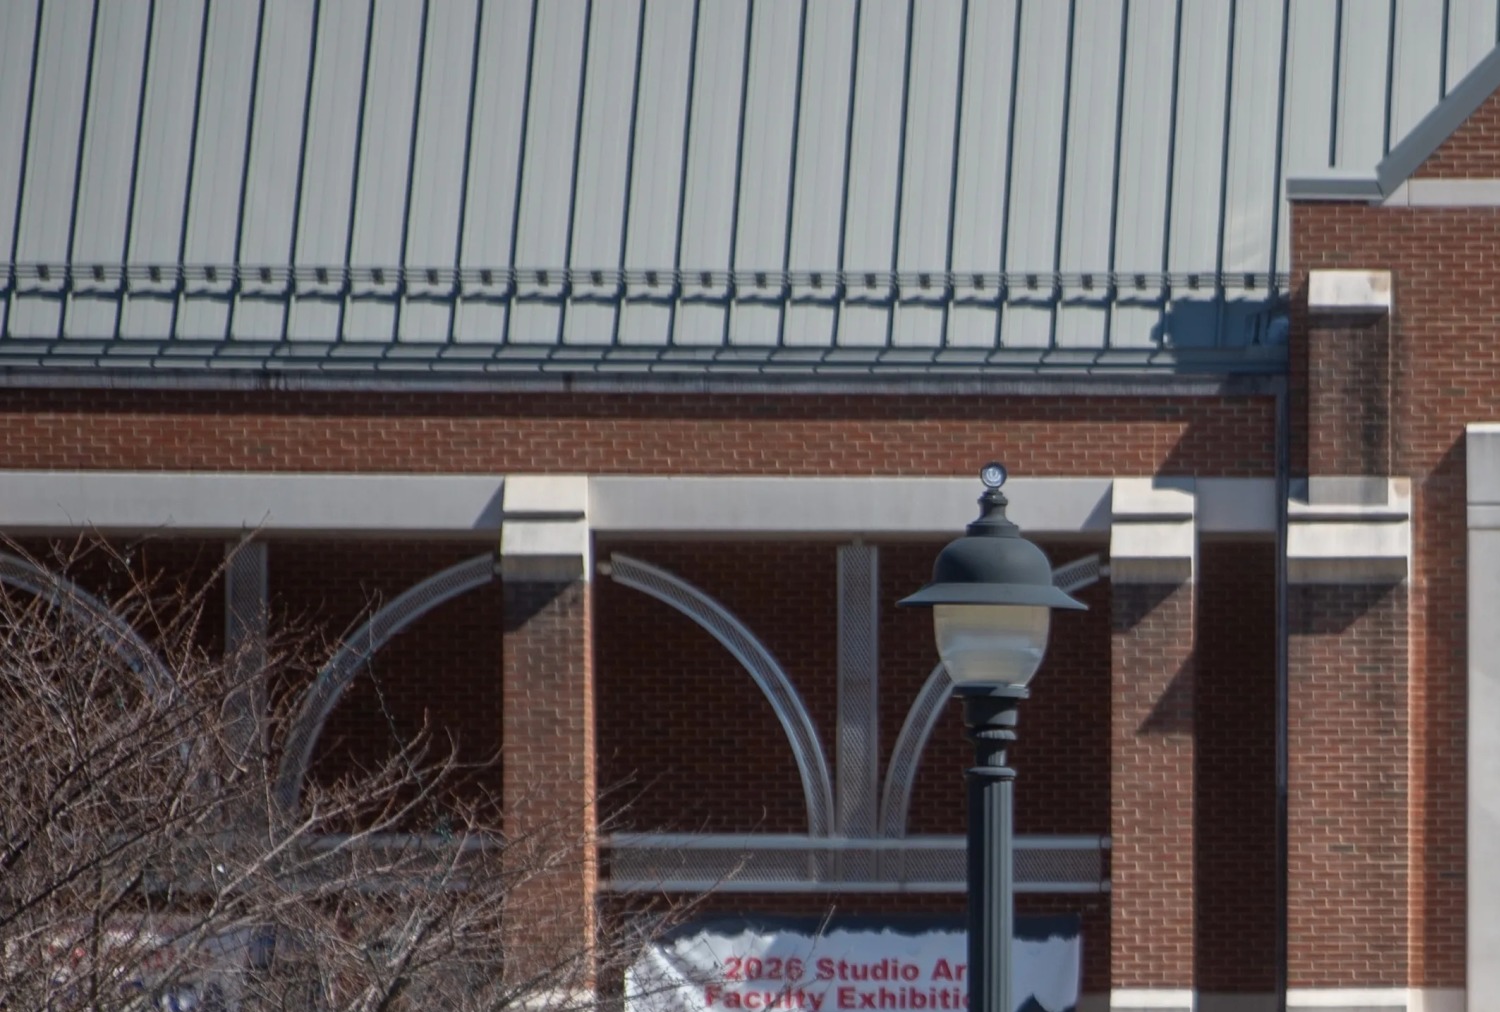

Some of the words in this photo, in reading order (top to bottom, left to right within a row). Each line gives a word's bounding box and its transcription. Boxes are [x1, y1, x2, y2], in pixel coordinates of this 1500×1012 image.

[723, 957, 803, 980] 2026
[816, 957, 920, 981] Studio
[931, 958, 967, 981] Ar
[837, 986, 968, 1009] Exhibiti
